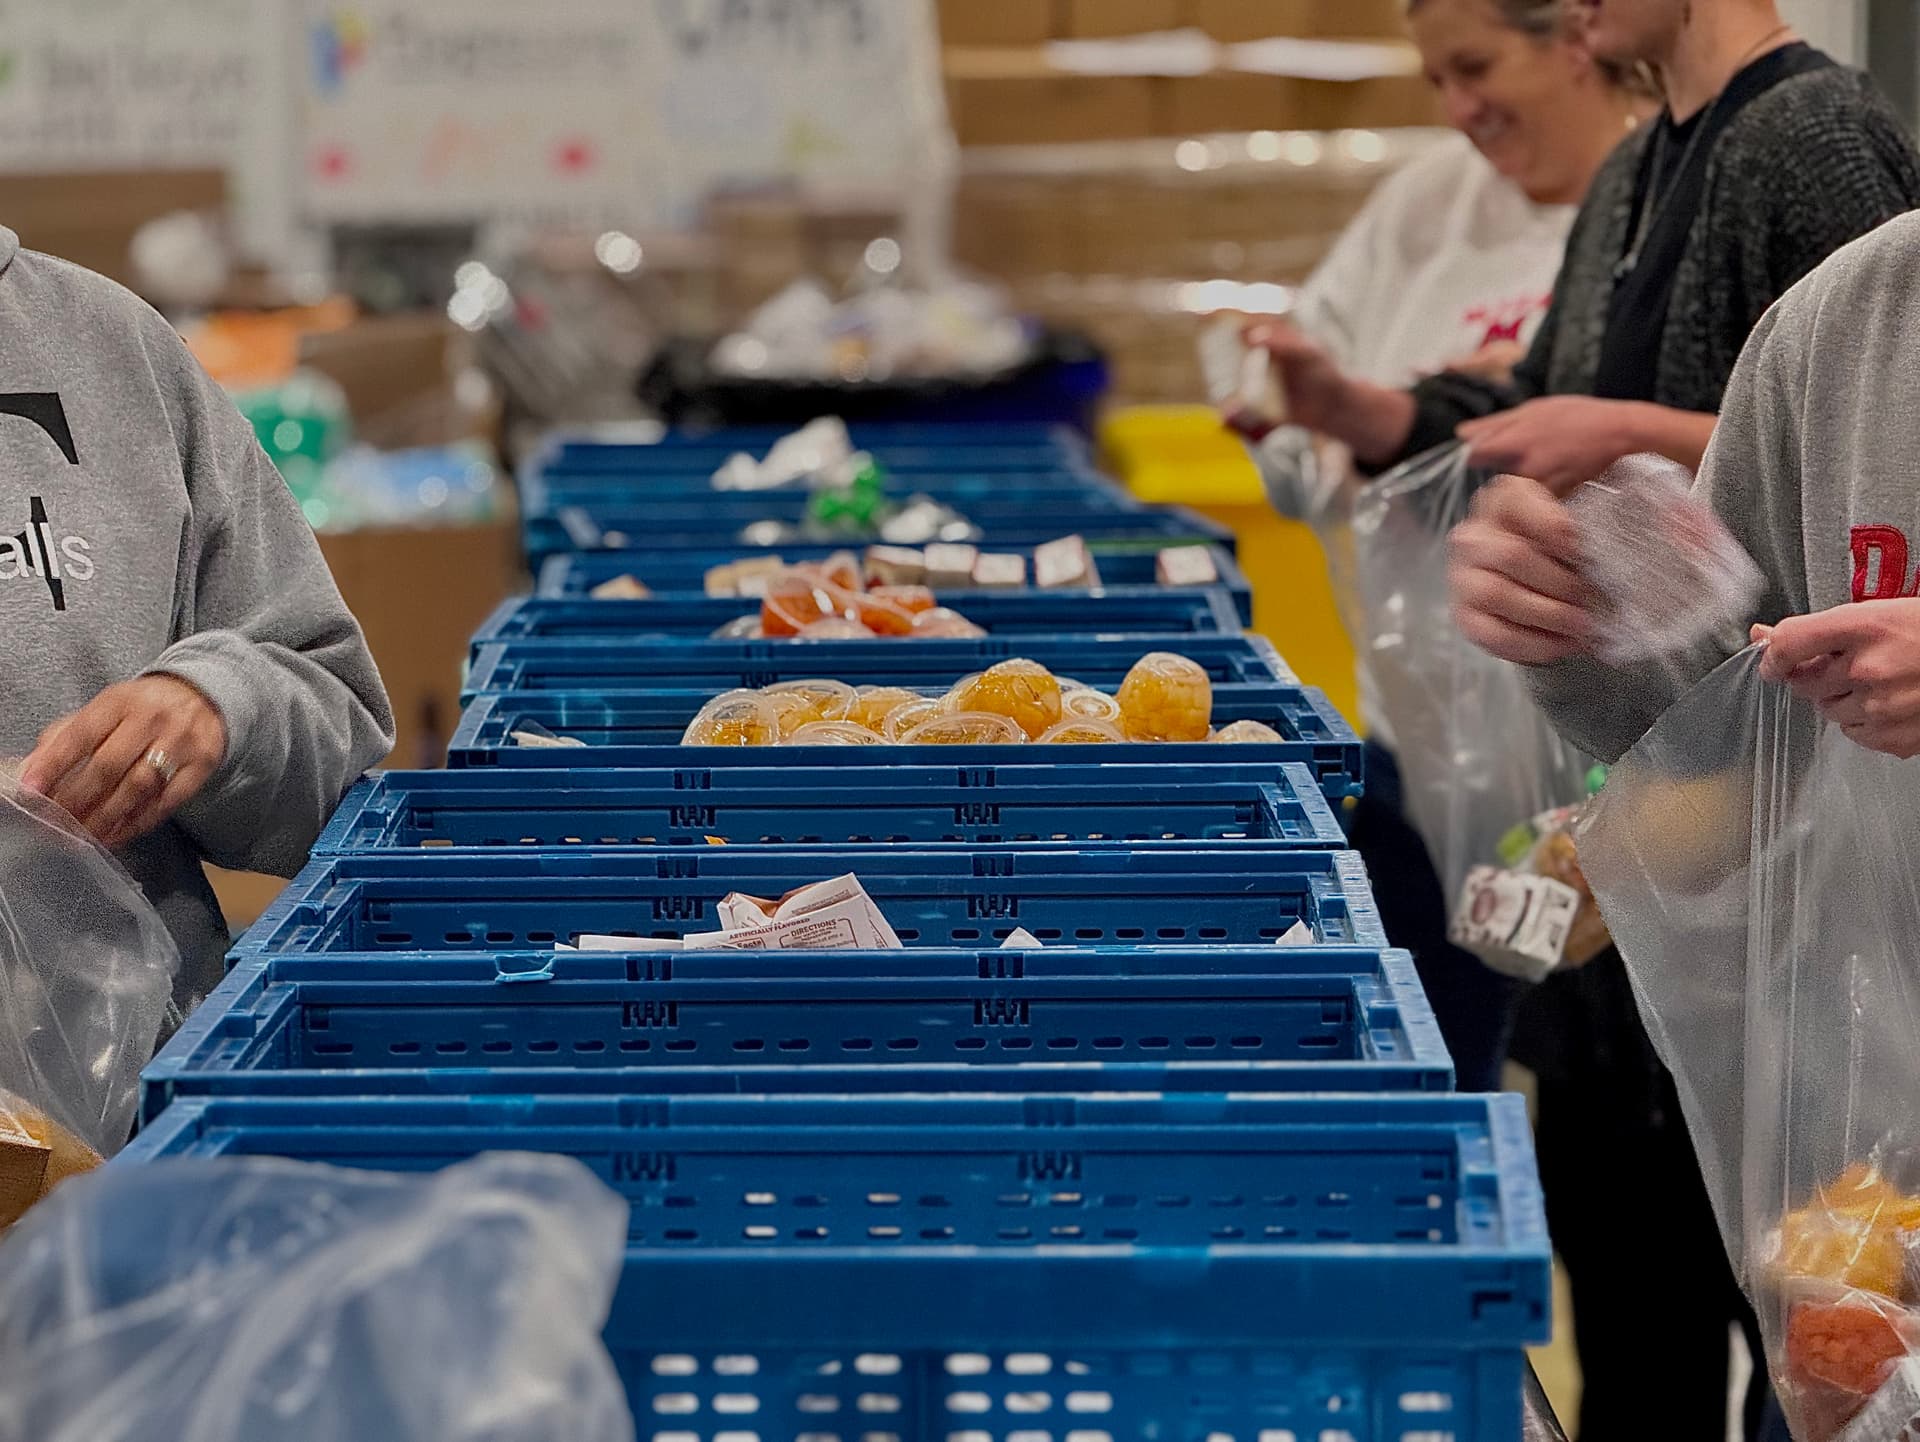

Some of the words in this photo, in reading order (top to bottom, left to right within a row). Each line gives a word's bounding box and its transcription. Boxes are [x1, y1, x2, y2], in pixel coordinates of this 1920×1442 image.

[1850, 524, 1920, 603] D
[729, 926, 774, 940] ARTIFICIALLY
[774, 917, 811, 931] FLAVORED
[790, 919, 837, 937] DIRECTIONS
[737, 939, 762, 949] Facts
